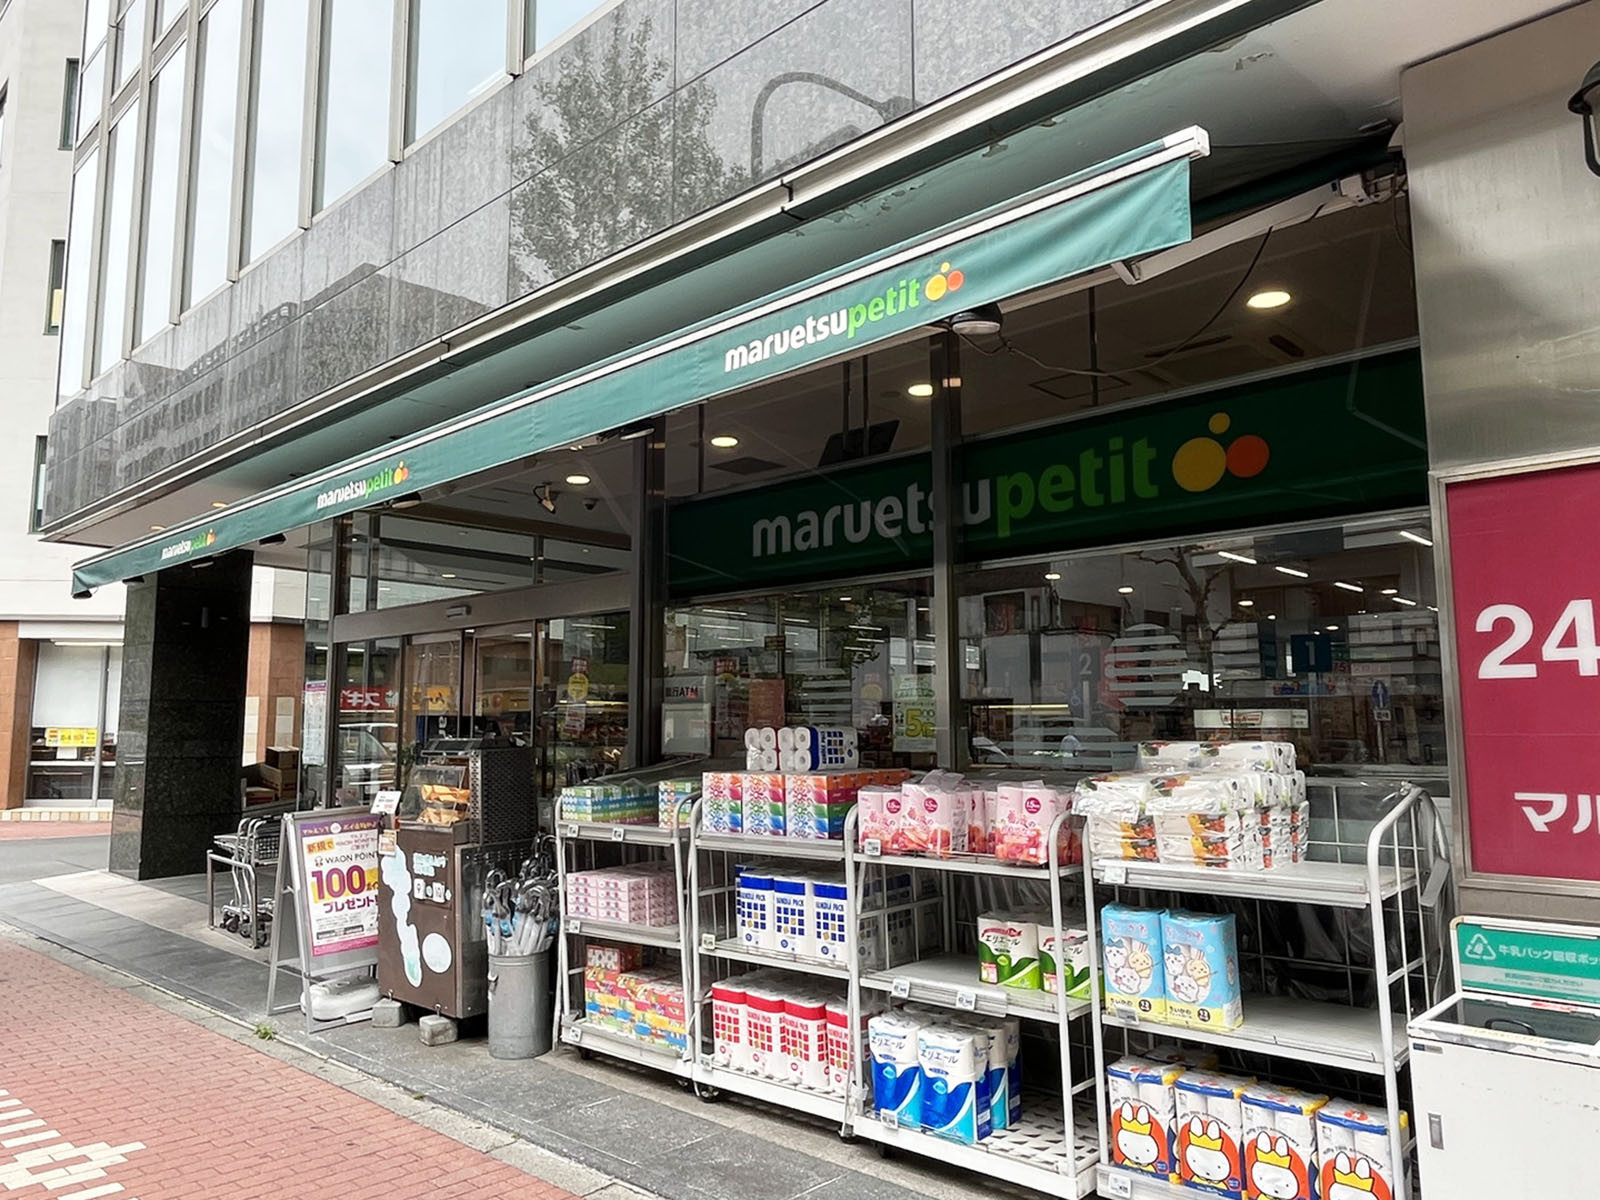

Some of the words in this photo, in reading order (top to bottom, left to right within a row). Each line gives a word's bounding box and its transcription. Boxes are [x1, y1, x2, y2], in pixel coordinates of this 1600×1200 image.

[725, 279, 920, 373] maruetsupetit
[1475, 599, 1600, 680] 24
[986, 934, 1021, 946] エリエール
[1499, 944, 1600, 965] 牛乳パック回収ボッ
[871, 1036, 905, 1049] エリエール
[920, 1050, 958, 1064] エリエール
